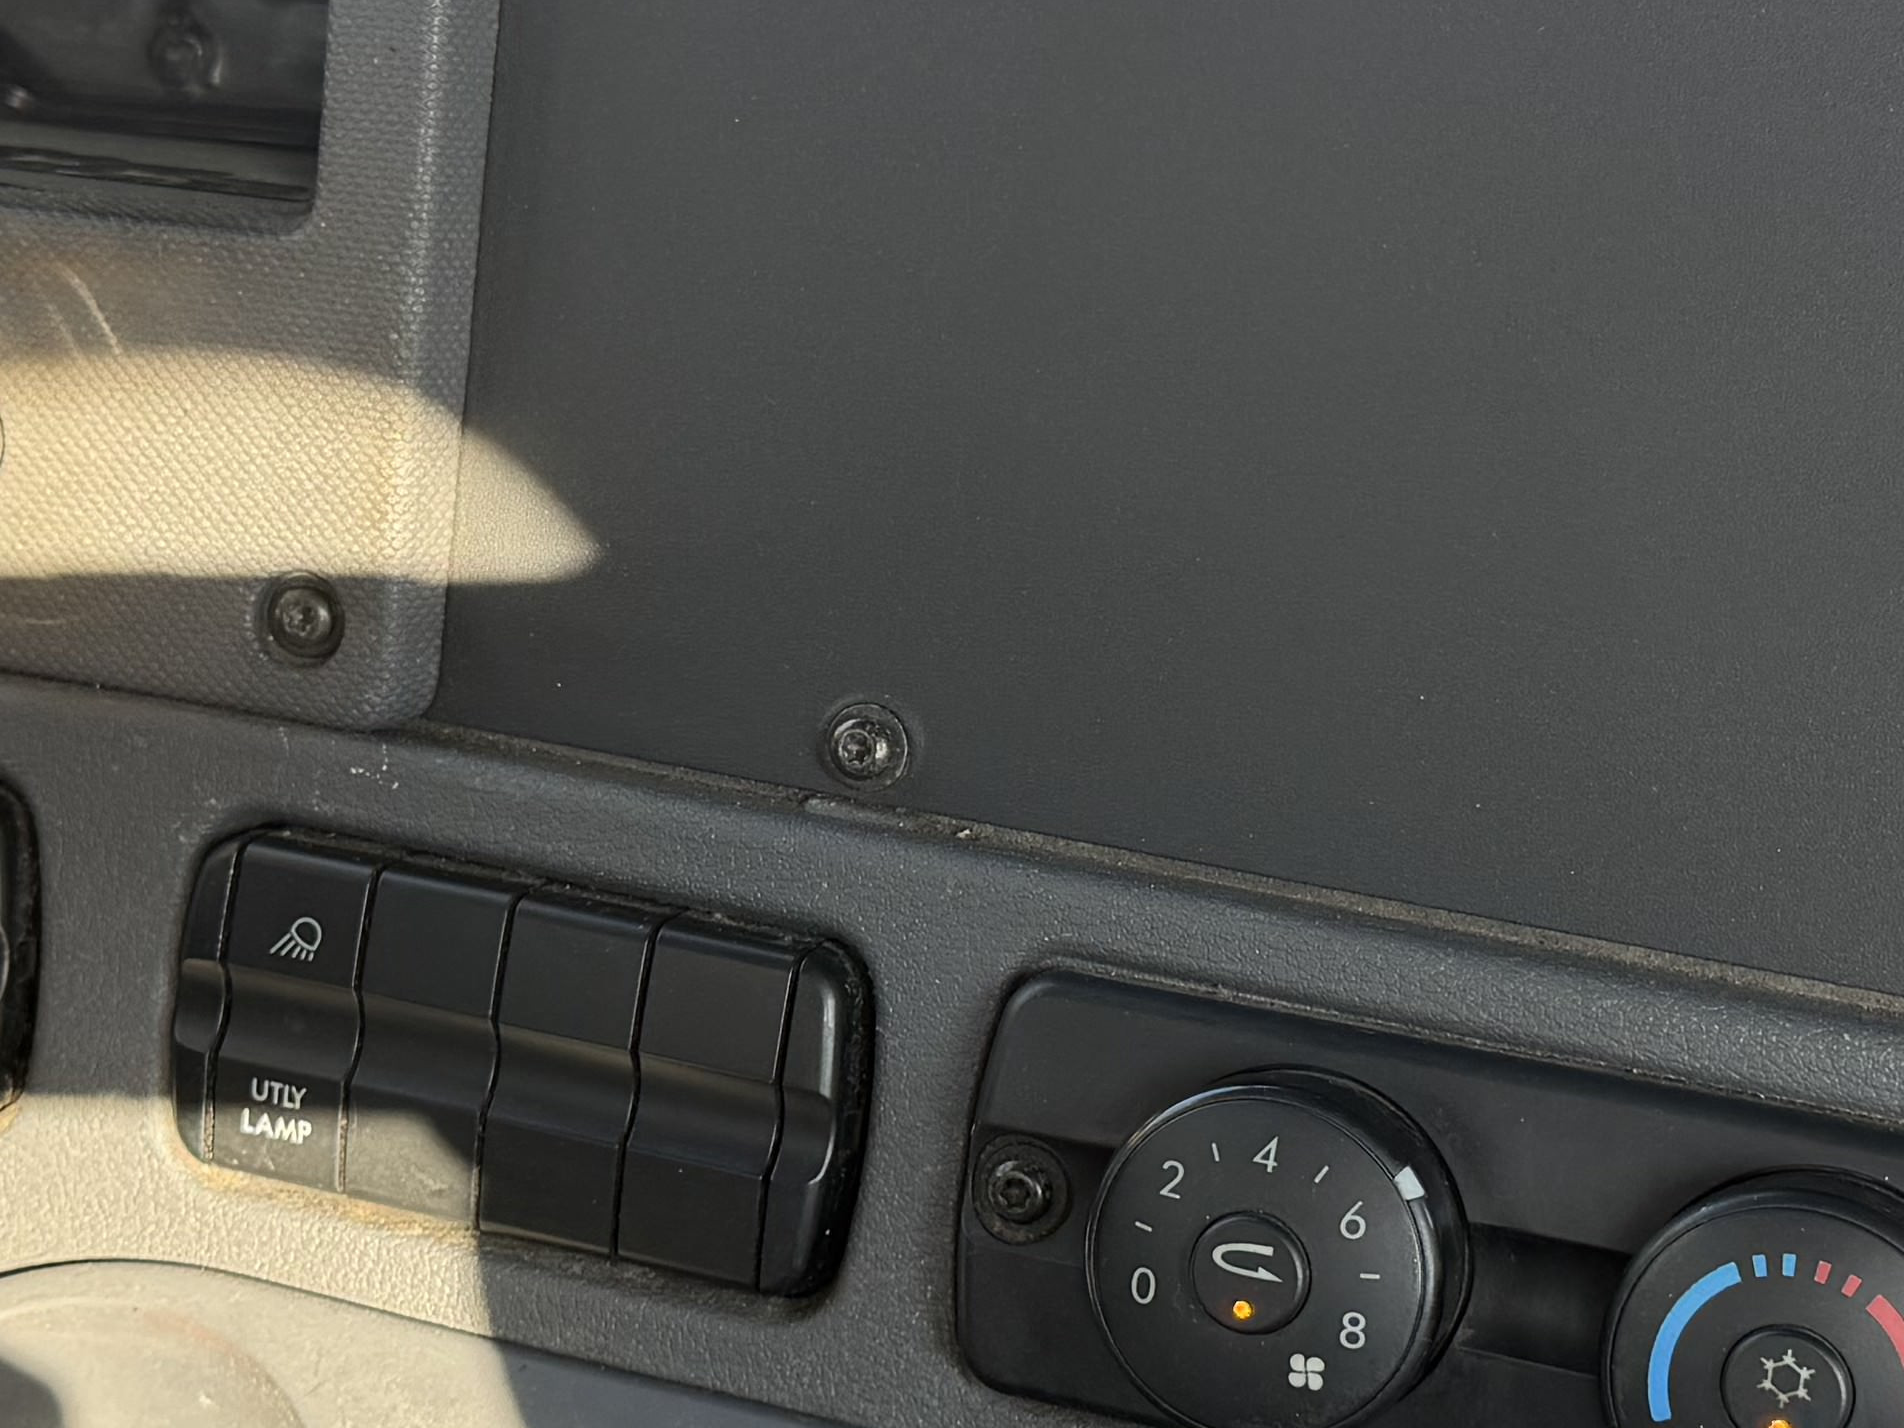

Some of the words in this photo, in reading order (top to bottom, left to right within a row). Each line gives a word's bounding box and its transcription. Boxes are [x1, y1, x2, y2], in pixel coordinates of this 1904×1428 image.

[250, 1077, 308, 1110] UTLY
[240, 1108, 313, 1144] LAMP
[1253, 1136, 1280, 1173] 4
[1159, 1160, 1185, 1199] 2
[1339, 1200, 1367, 1240] 6
[1131, 1267, 1156, 1304] 0
[1339, 1312, 1367, 1349] 8
